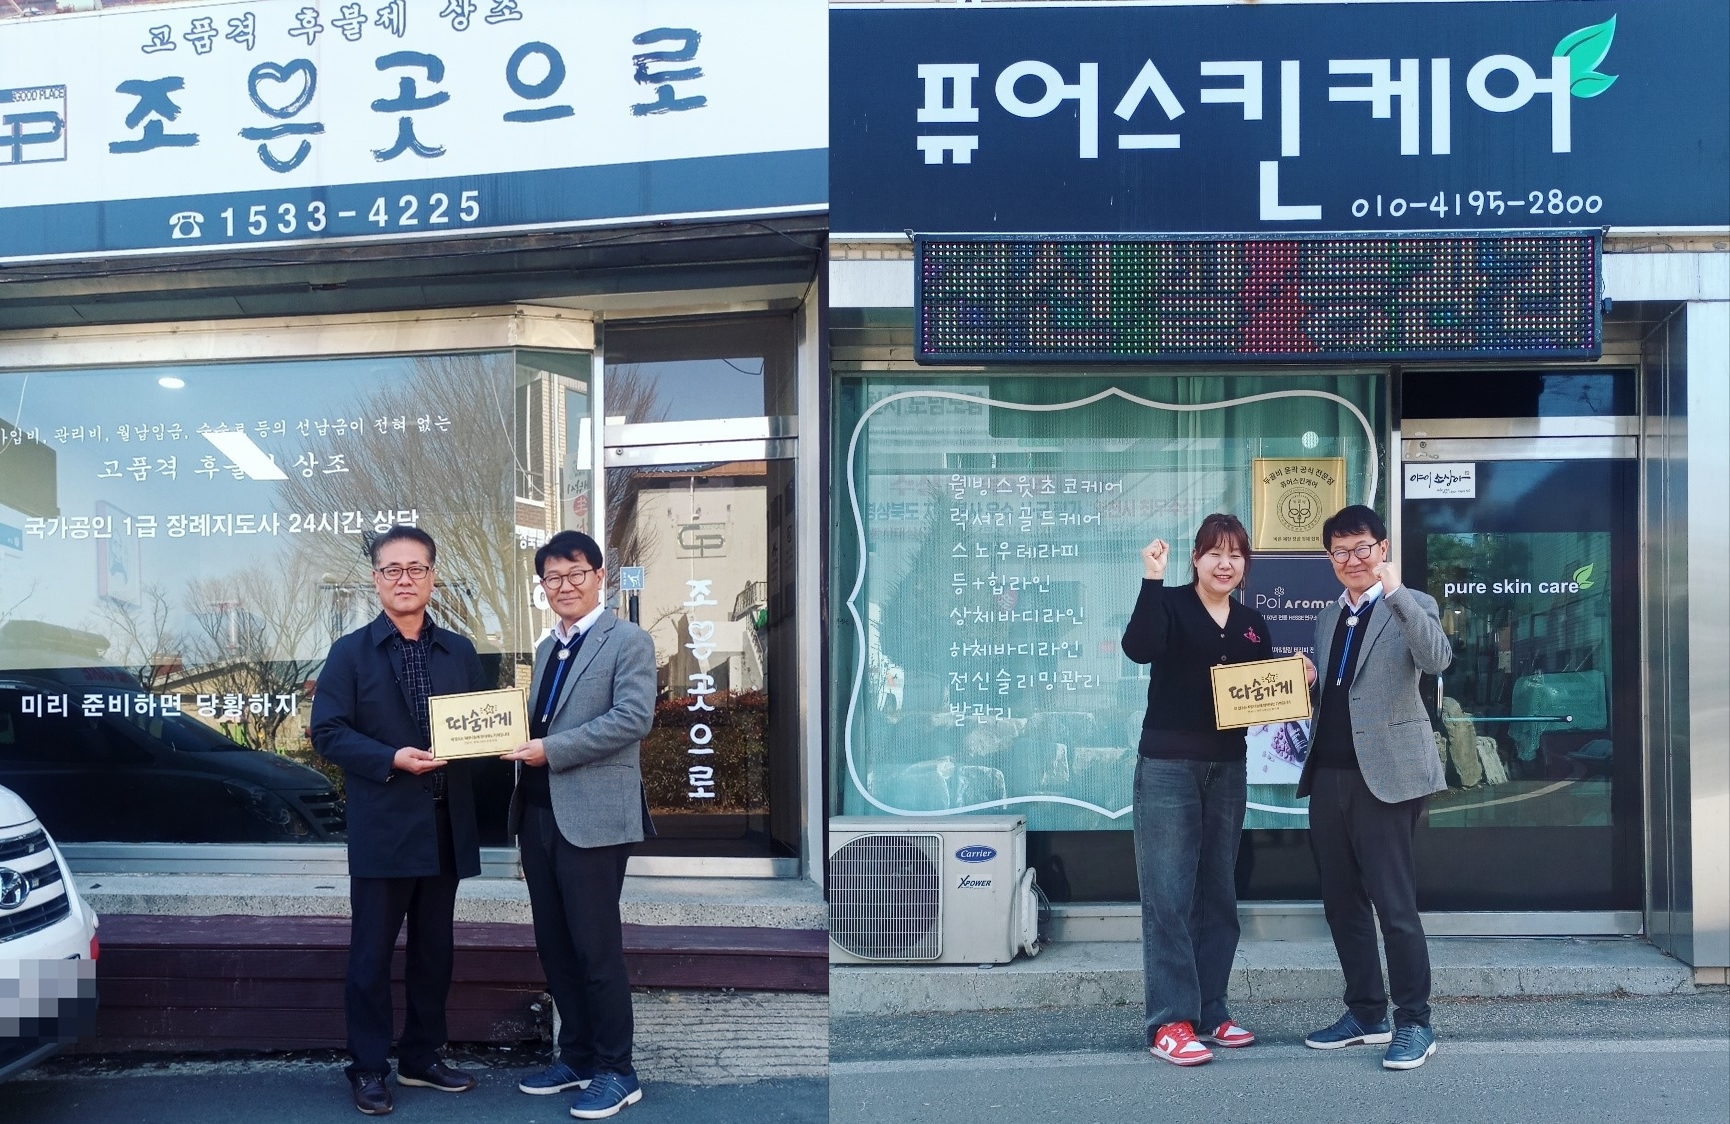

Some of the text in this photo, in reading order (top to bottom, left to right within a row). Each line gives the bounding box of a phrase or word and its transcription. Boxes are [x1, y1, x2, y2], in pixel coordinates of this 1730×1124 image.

[141, 12, 256, 55] 고품격
[288, 0, 406, 45] 후불제
[39, 88, 65, 100] PLACE
[915, 53, 1572, 222] 퓨어스킨케어
[220, 189, 481, 238] 1533-4225
[1351, 190, 1603, 218] 010-4195-2800
[54, 424, 109, 443] 관리비,
[116, 422, 189, 442] 월납입금,
[254, 418, 287, 439] 등의
[295, 417, 364, 437] 선납금이
[373, 415, 407, 433] 전혀
[416, 413, 452, 433] 없는
[97, 454, 178, 482] 고품격
[292, 451, 350, 478] 상조
[24, 515, 112, 539] 국가공인
[123, 515, 157, 538] 1급
[166, 513, 280, 537] 장례지도사
[289, 510, 363, 535] 24시간
[1443, 577, 1579, 597] pure skin care
[1256, 594, 1280, 608] Poi
[949, 606, 1084, 626] 상체바디라인
[949, 640, 1080, 659] 하체바디라인
[948, 668, 1101, 695] 전신슬리밍관리
[1228, 678, 1293, 702] 따숨가게
[21, 692, 298, 718] 미리 준비하면 당황하지
[949, 702, 1012, 727] 발관리
[445, 709, 512, 733] 따숨가게
[960, 849, 992, 858] Carrier
